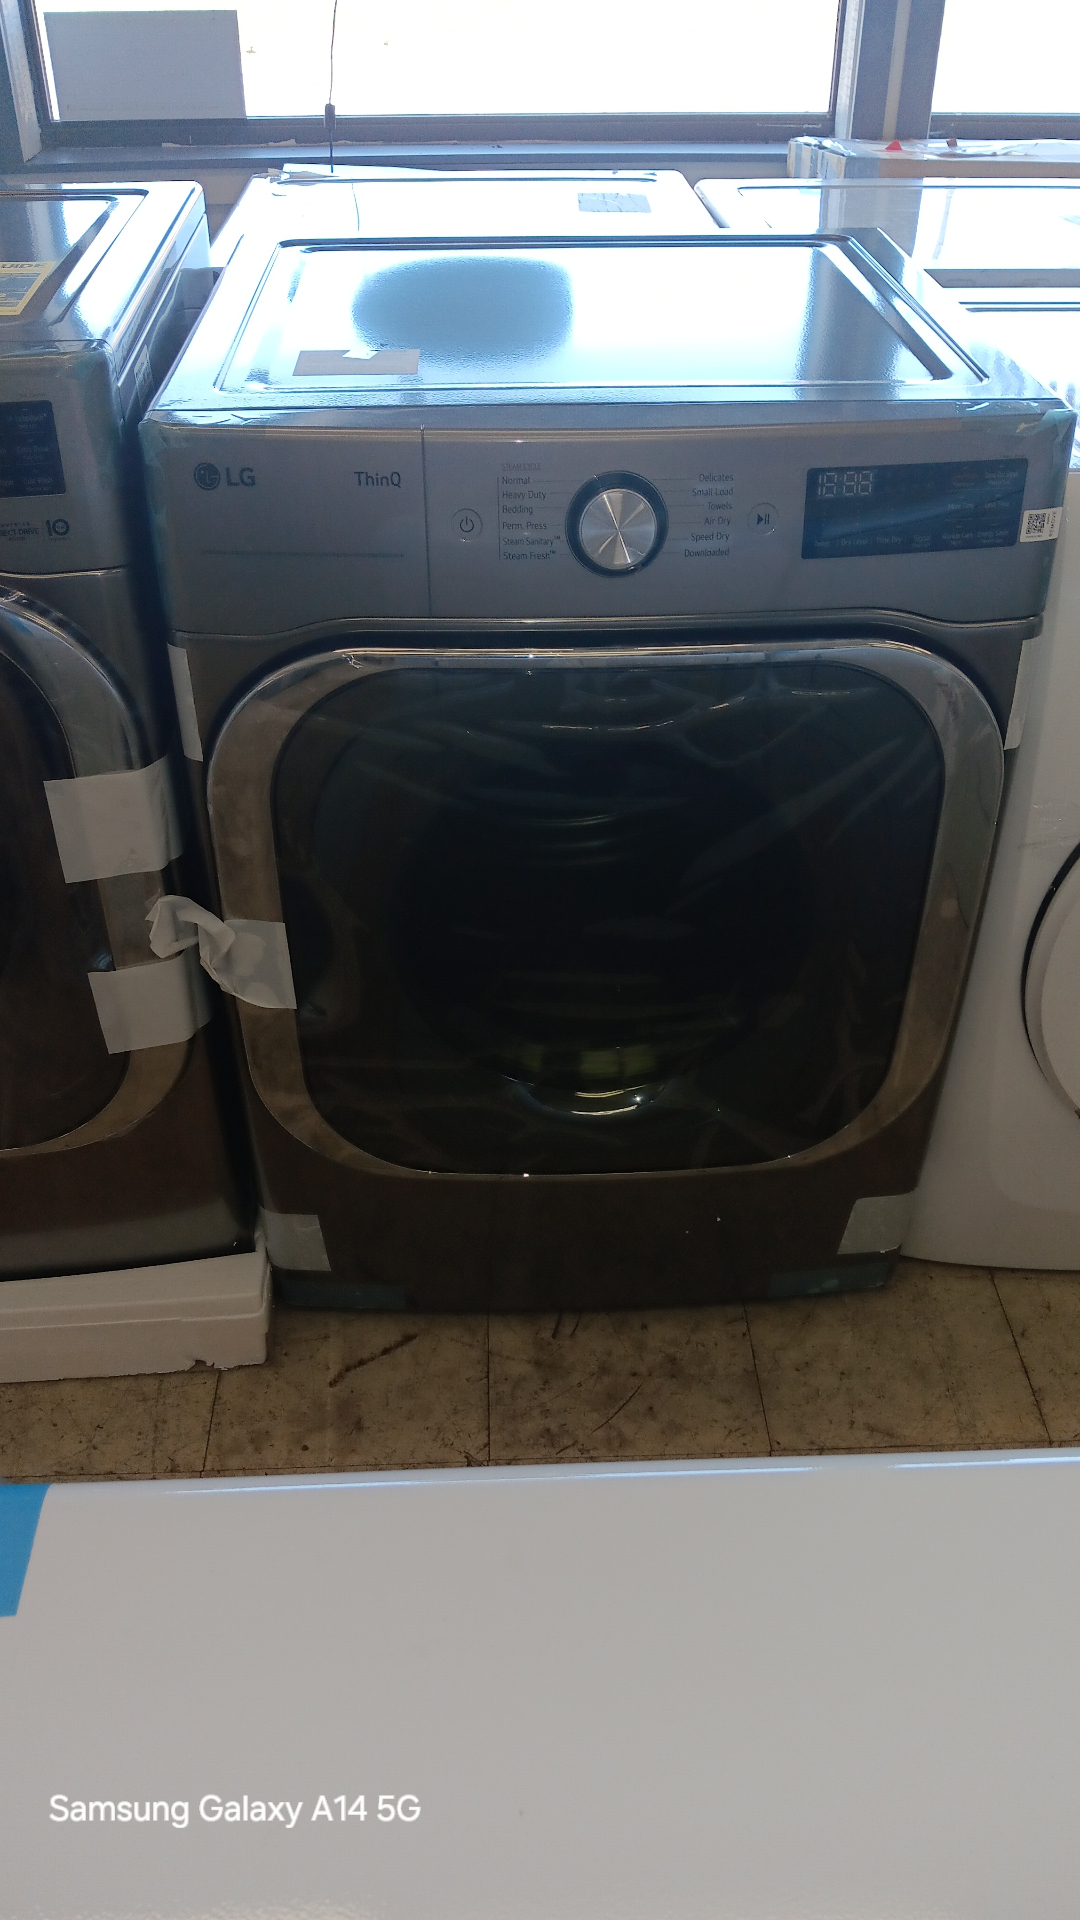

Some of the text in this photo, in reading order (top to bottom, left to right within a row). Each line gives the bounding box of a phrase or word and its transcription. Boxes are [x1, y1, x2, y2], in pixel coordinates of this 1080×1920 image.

[226, 467, 256, 487] LG
[354, 471, 402, 489] ThinQ
[502, 476, 530, 485] Normal
[699, 473, 734, 482] Delicates
[502, 490, 547, 501] Heavy Duty
[692, 487, 734, 496] Small Load
[502, 505, 533, 515] Bedding
[707, 502, 733, 510] Towels
[526, 521, 548, 530] Press
[704, 516, 731, 526] Air Dry
[18, 528, 40, 536] DRIVE
[45, 518, 70, 537] 10
[503, 537, 525, 546] Steam
[691, 531, 730, 543] Speed Dry
[503, 551, 528, 560] Steam
[684, 547, 730, 557] Downloaded
